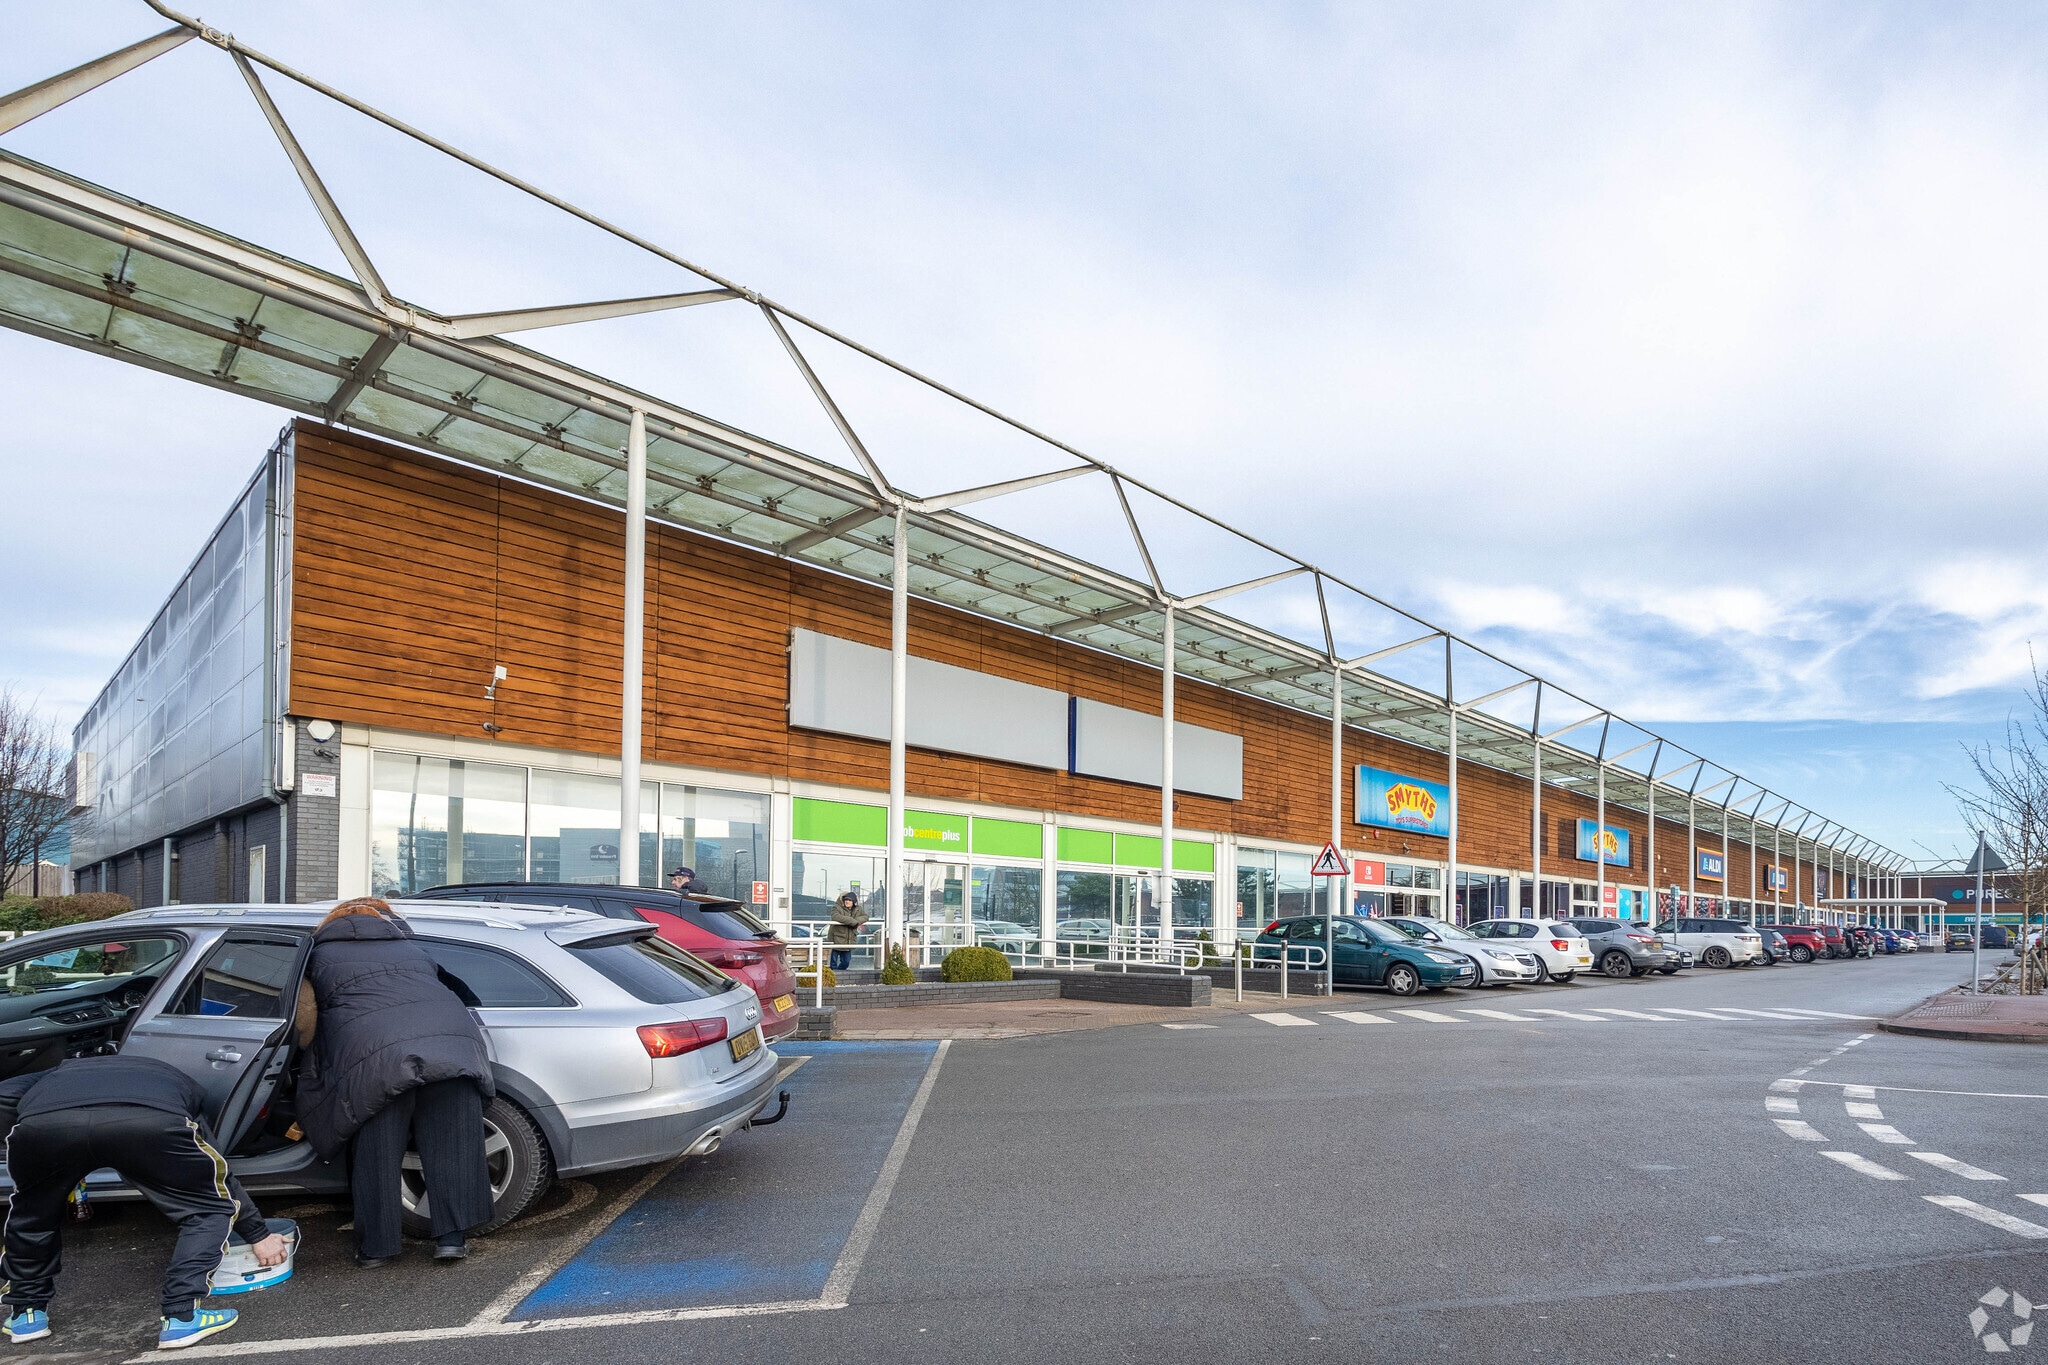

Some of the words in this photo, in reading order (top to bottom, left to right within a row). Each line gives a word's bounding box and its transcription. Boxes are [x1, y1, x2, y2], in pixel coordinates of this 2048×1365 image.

[1388, 787, 1436, 819] SMYTHS
[904, 826, 960, 842] obcentreplus
[1594, 833, 1618, 854] STHS
[1708, 858, 1722, 873] ALDI
